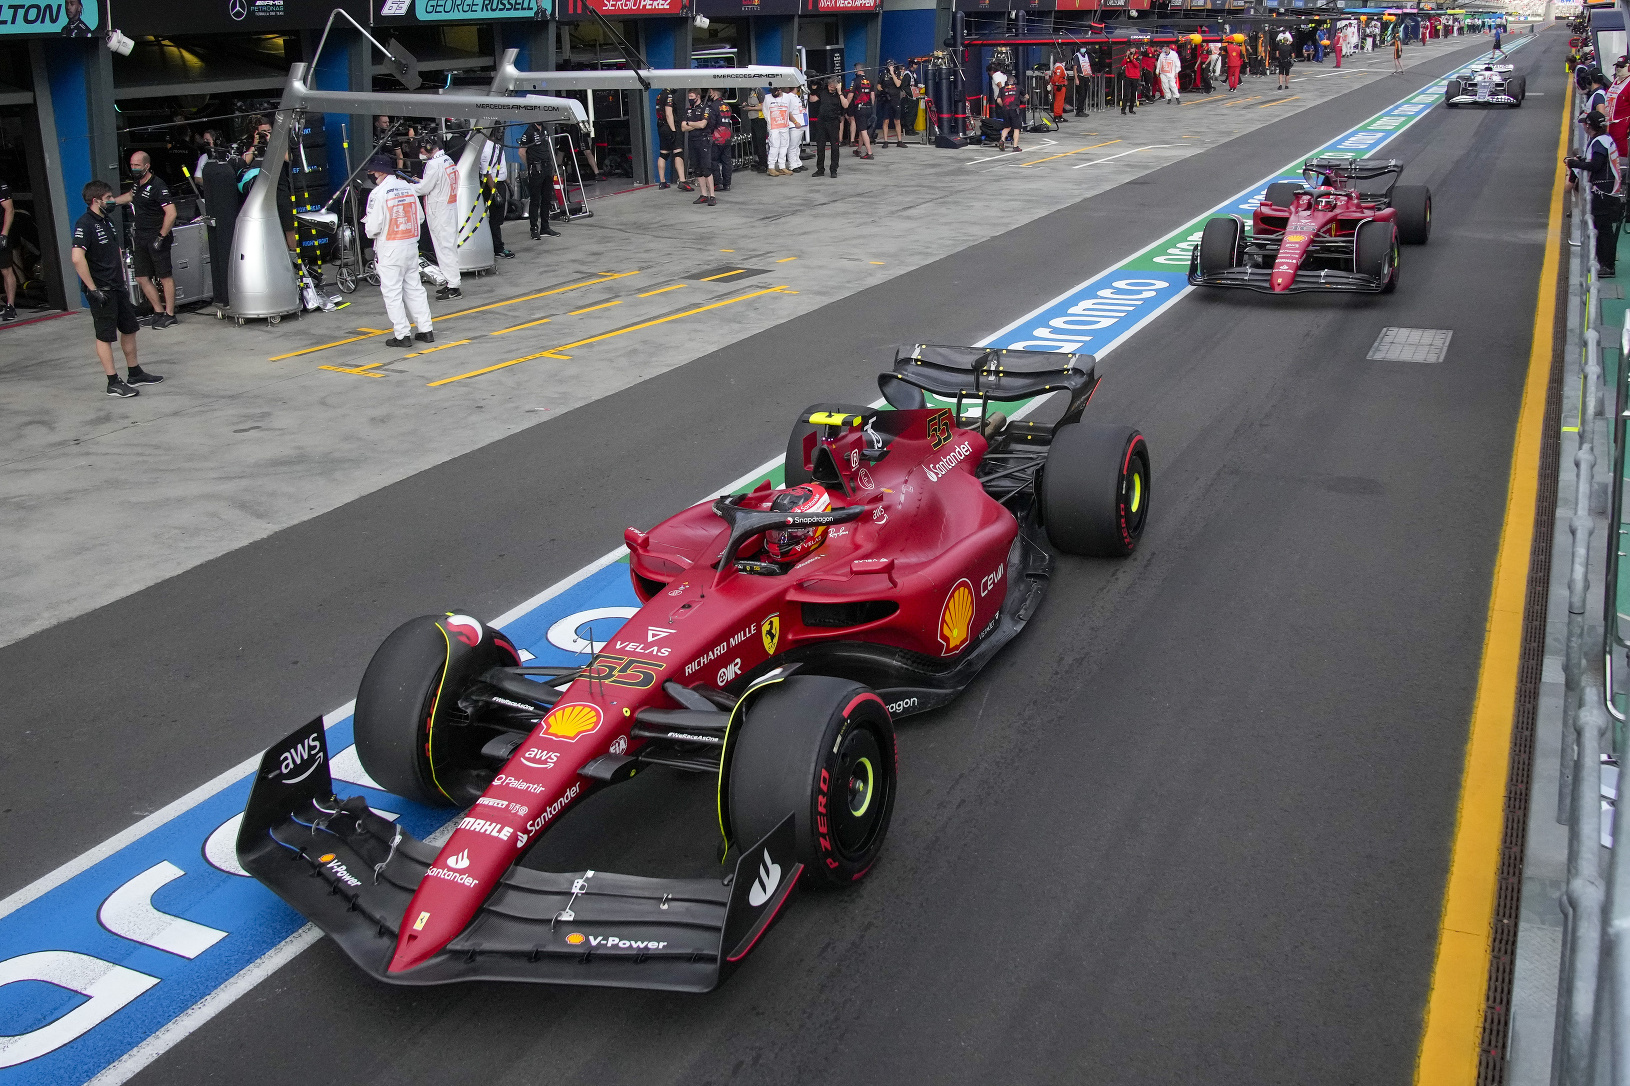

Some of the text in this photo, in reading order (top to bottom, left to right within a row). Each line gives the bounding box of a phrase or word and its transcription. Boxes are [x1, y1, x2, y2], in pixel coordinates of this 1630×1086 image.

[425, 0, 534, 13] GEORGE RUSSELL
[602, 0, 670, 10] SERGIO PEREZ
[1007, 279, 1170, 354] aramco
[926, 408, 954, 451] 55
[930, 440, 974, 478] Santander
[795, 515, 834, 525] Snapdragon
[873, 506, 887, 523] aws
[615, 640, 672, 657] VELAS
[684, 622, 758, 677] RICHARD MILLE
[576, 653, 667, 689] 55
[667, 731, 719, 742] #WeRaceAsOne
[279, 732, 322, 778] aws
[523, 748, 561, 766] aws
[503, 776, 546, 794] Palantir
[476, 797, 508, 808] PIRELLI
[526, 781, 582, 837] Santander
[457, 817, 514, 841] MAHLE
[817, 767, 839, 870] P ZERO
[326, 858, 362, 887] V-Power
[425, 865, 479, 888] Santander
[588, 934, 668, 950] V-Power
